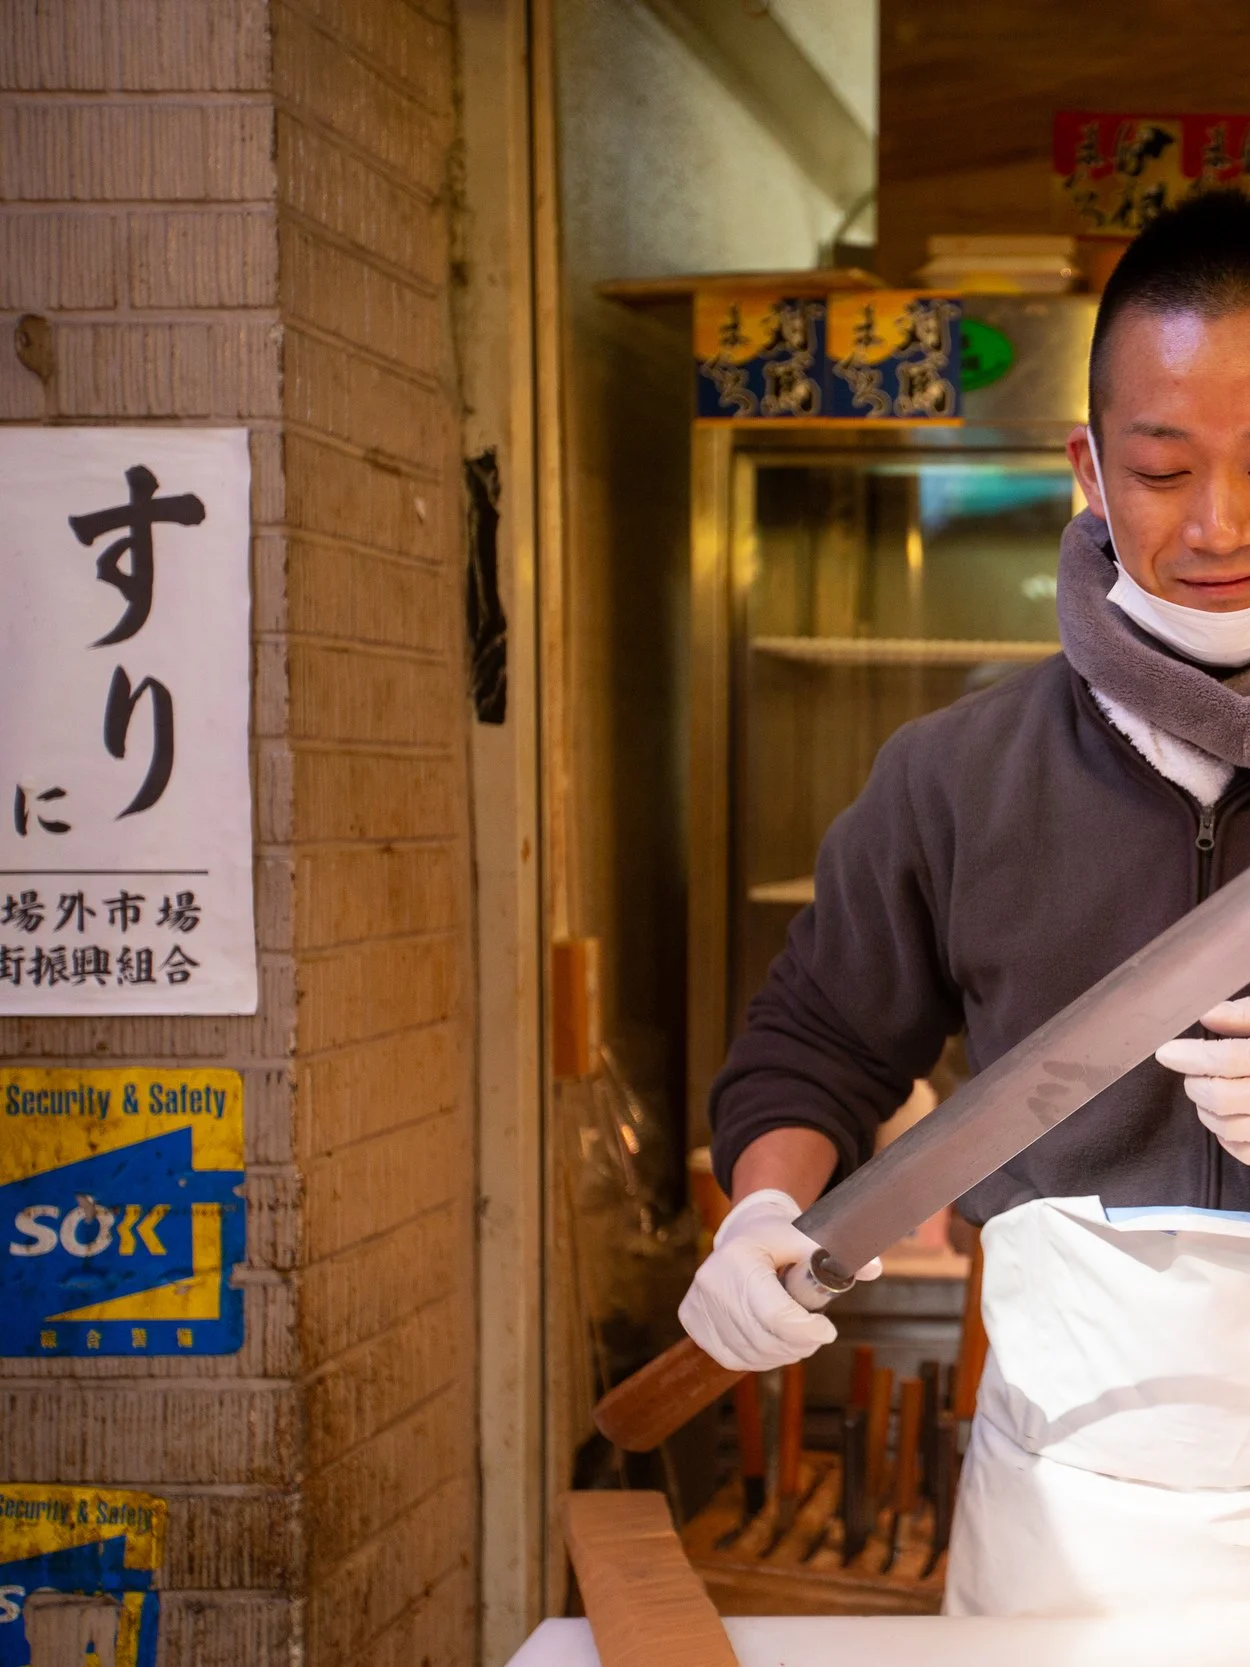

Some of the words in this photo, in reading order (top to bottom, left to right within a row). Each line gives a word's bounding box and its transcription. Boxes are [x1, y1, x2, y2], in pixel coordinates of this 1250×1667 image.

[68, 463, 206, 821] すり
[14, 784, 72, 837] に
[1, 889, 202, 934] 場外市場
[6, 1083, 110, 1119] Security
[123, 1083, 139, 1115] &
[149, 1083, 226, 1120] Safety
[10, 1204, 168, 1257] SOK
[77, 1499, 90, 1524] &
[96, 1501, 152, 1535] Safety
